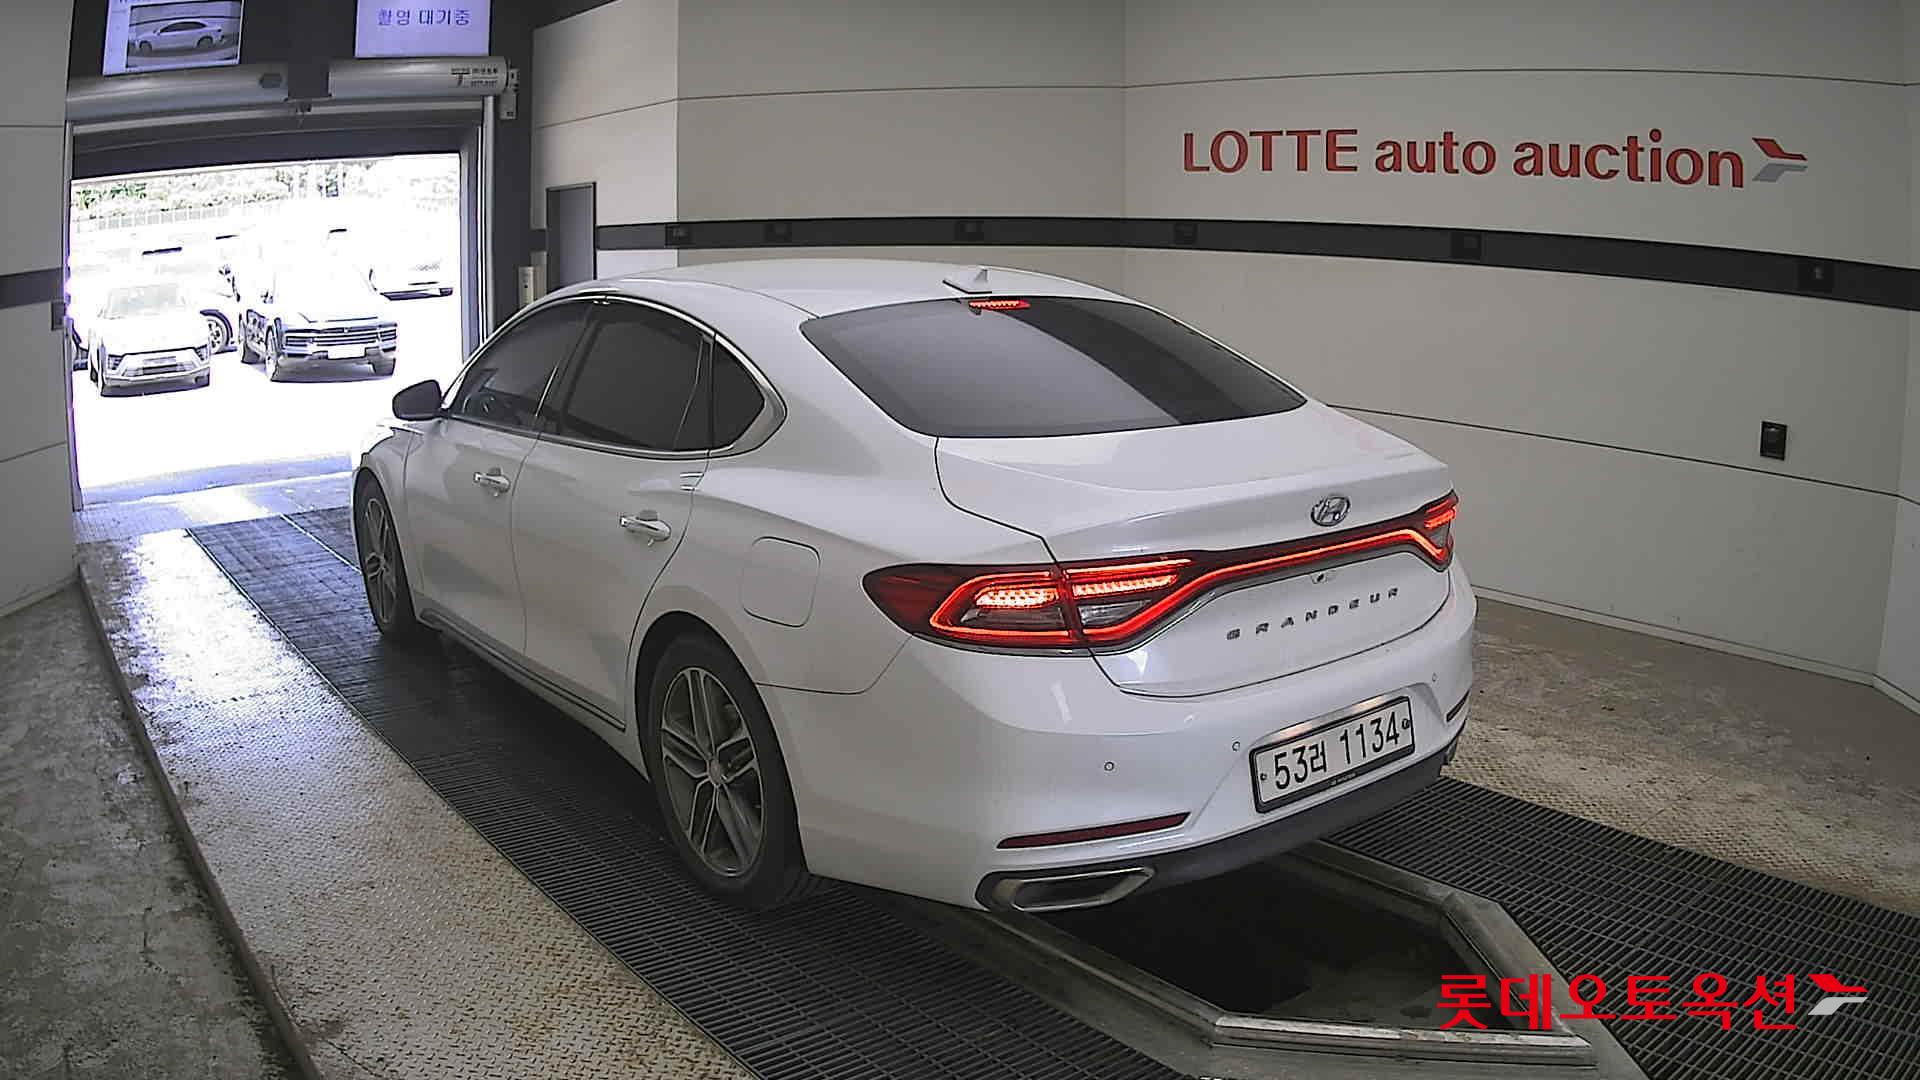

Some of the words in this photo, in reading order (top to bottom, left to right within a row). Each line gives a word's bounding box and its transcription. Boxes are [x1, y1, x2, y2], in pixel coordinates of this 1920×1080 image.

[419, 8, 470, 26] 대기중
[1183, 129, 1359, 173] LOTTE
[1375, 131, 1497, 175] auto
[1512, 128, 1744, 188] auction
[1226, 587, 1399, 640] GRANDEUR
[1274, 740, 1328, 790] 53러
[1340, 711, 1400, 764] 1134
